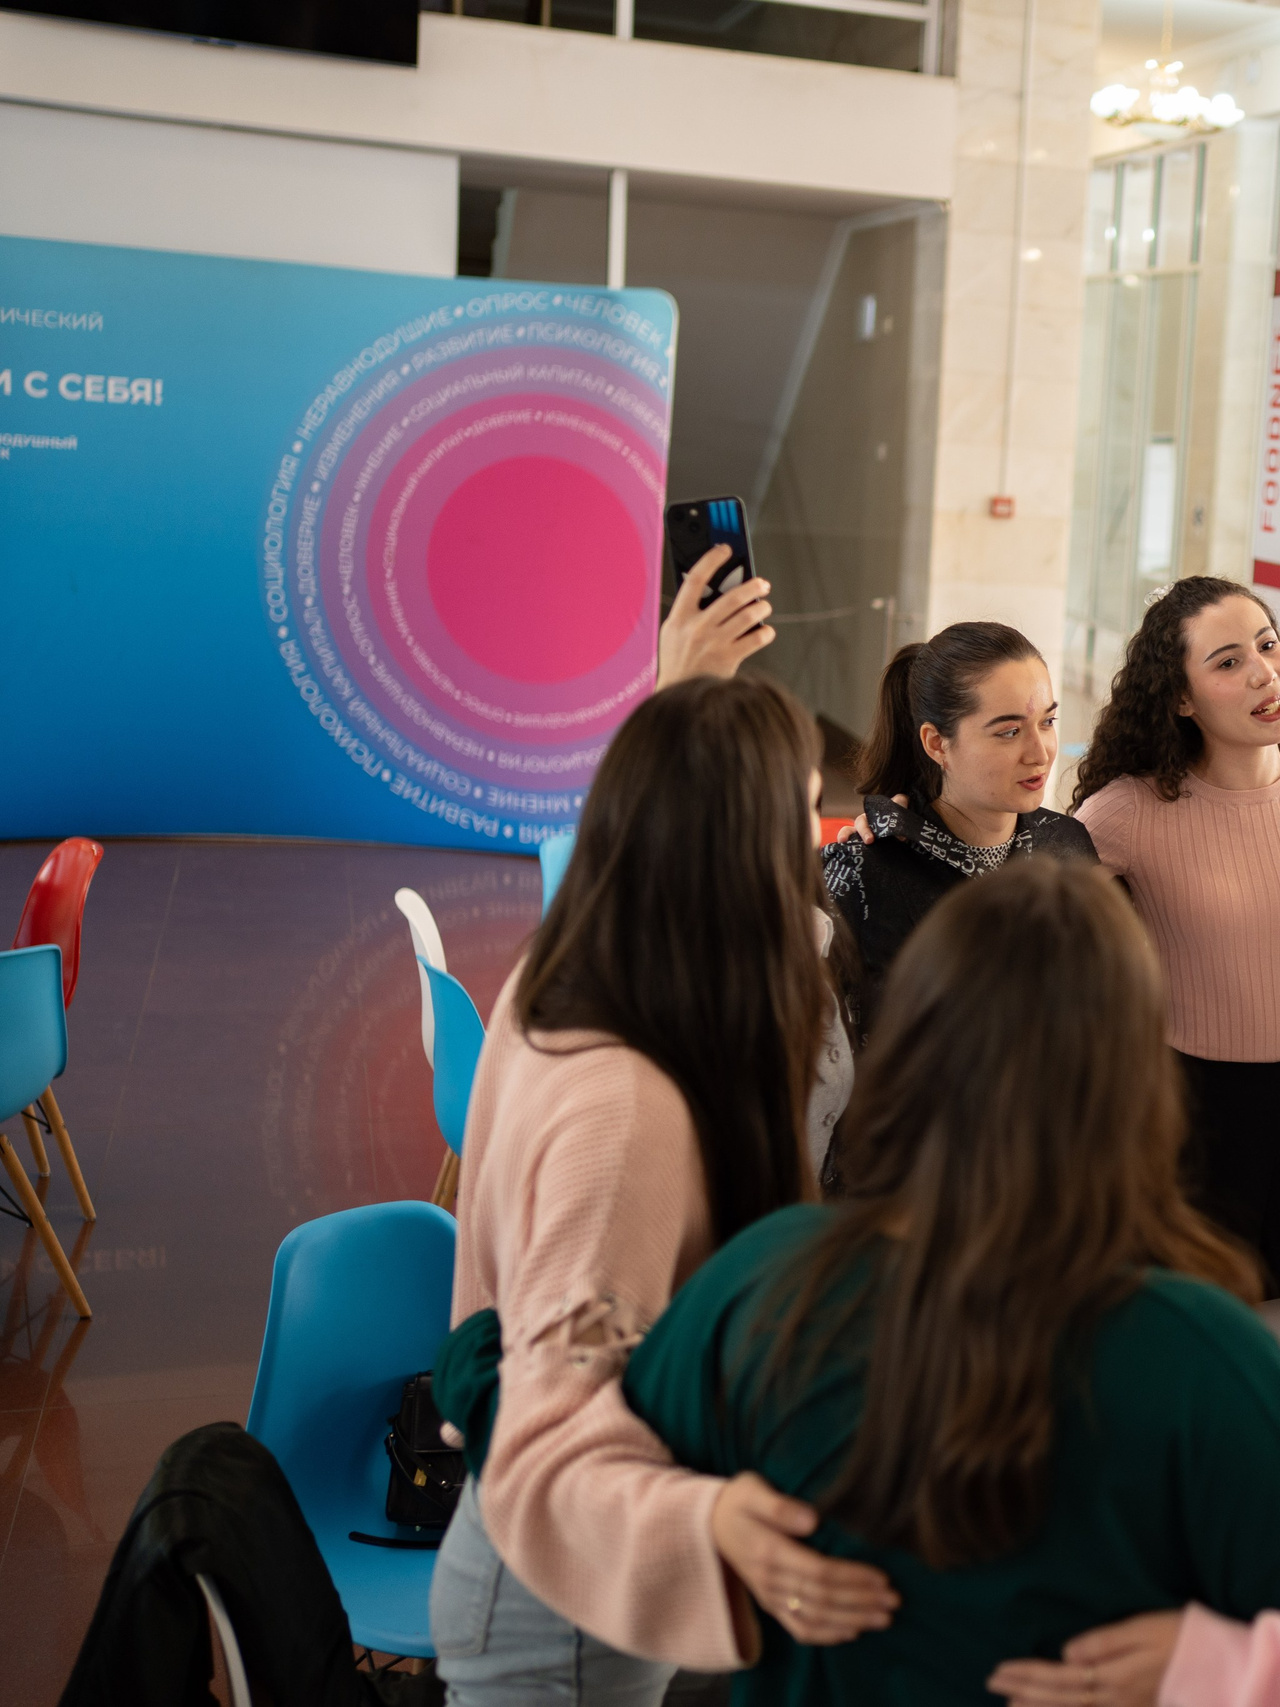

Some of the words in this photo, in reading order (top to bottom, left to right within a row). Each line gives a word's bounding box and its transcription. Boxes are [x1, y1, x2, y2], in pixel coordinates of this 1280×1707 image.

[466, 291, 549, 318] ОПРОС
[563, 294, 665, 350] ЧЕЛОВЕК
[526, 321, 662, 382] ПСИХОЛОГИЯ
[23, 370, 49, 399] С
[58, 373, 164, 406] СЕБЯ!
[263, 453, 301, 623] СОЦИОЛОГИЯ
[279, 639, 384, 778] ПСИХОЛОГИЯ
[388, 773, 500, 838] РАЗВИТИЕ
[486, 786, 571, 815] МНЕНИЕ
